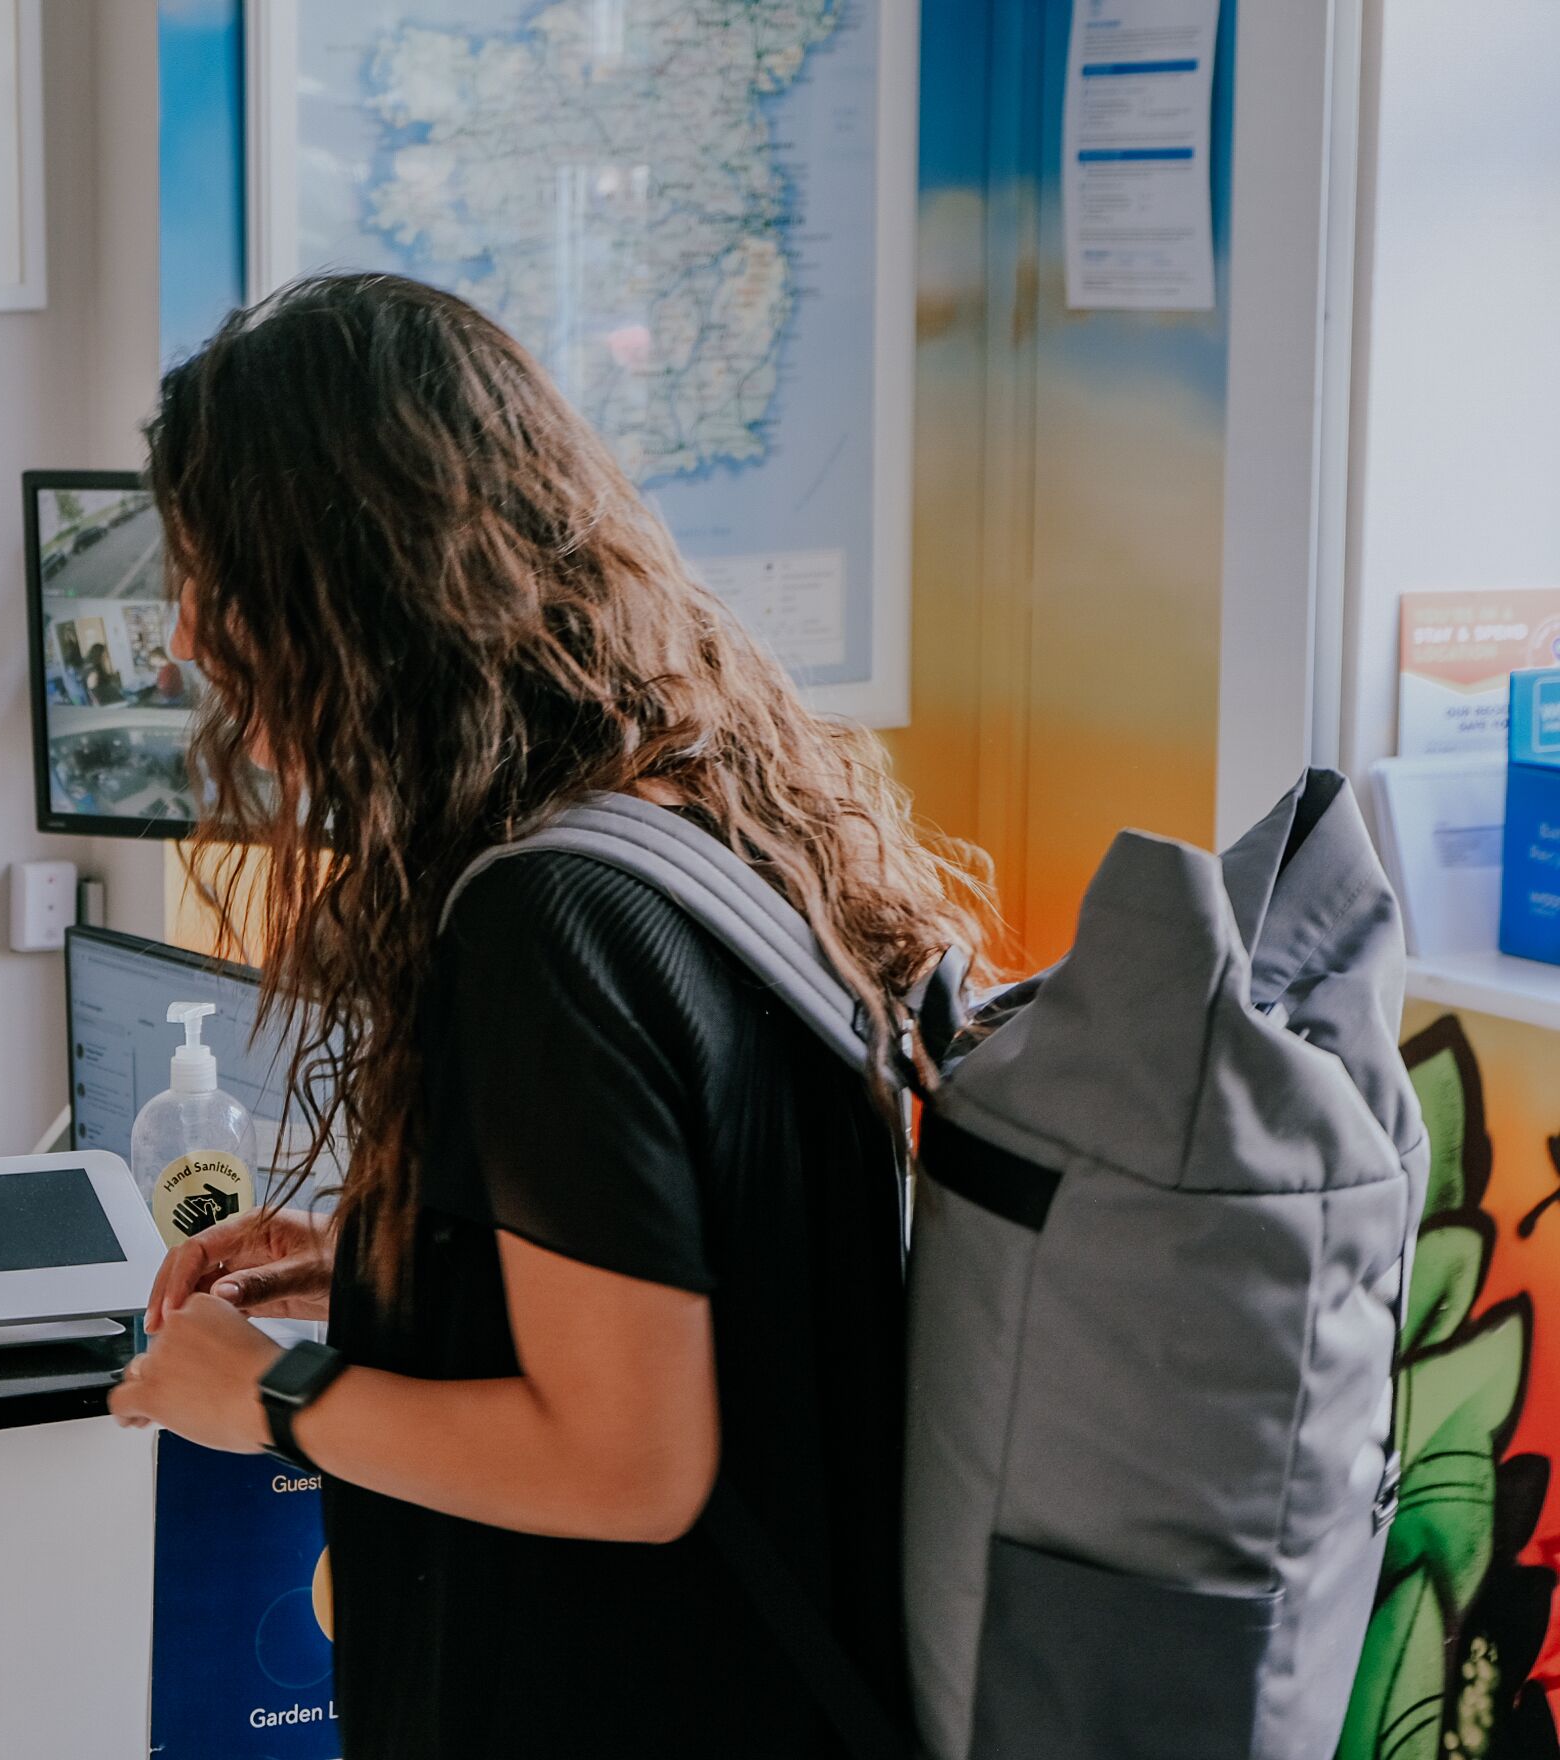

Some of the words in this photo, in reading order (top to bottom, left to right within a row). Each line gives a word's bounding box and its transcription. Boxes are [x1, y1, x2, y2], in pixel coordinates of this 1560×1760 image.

[163, 1166, 192, 1192] Hand
[194, 1161, 241, 1184] Sanitiser
[250, 1703, 323, 1729] Garden
